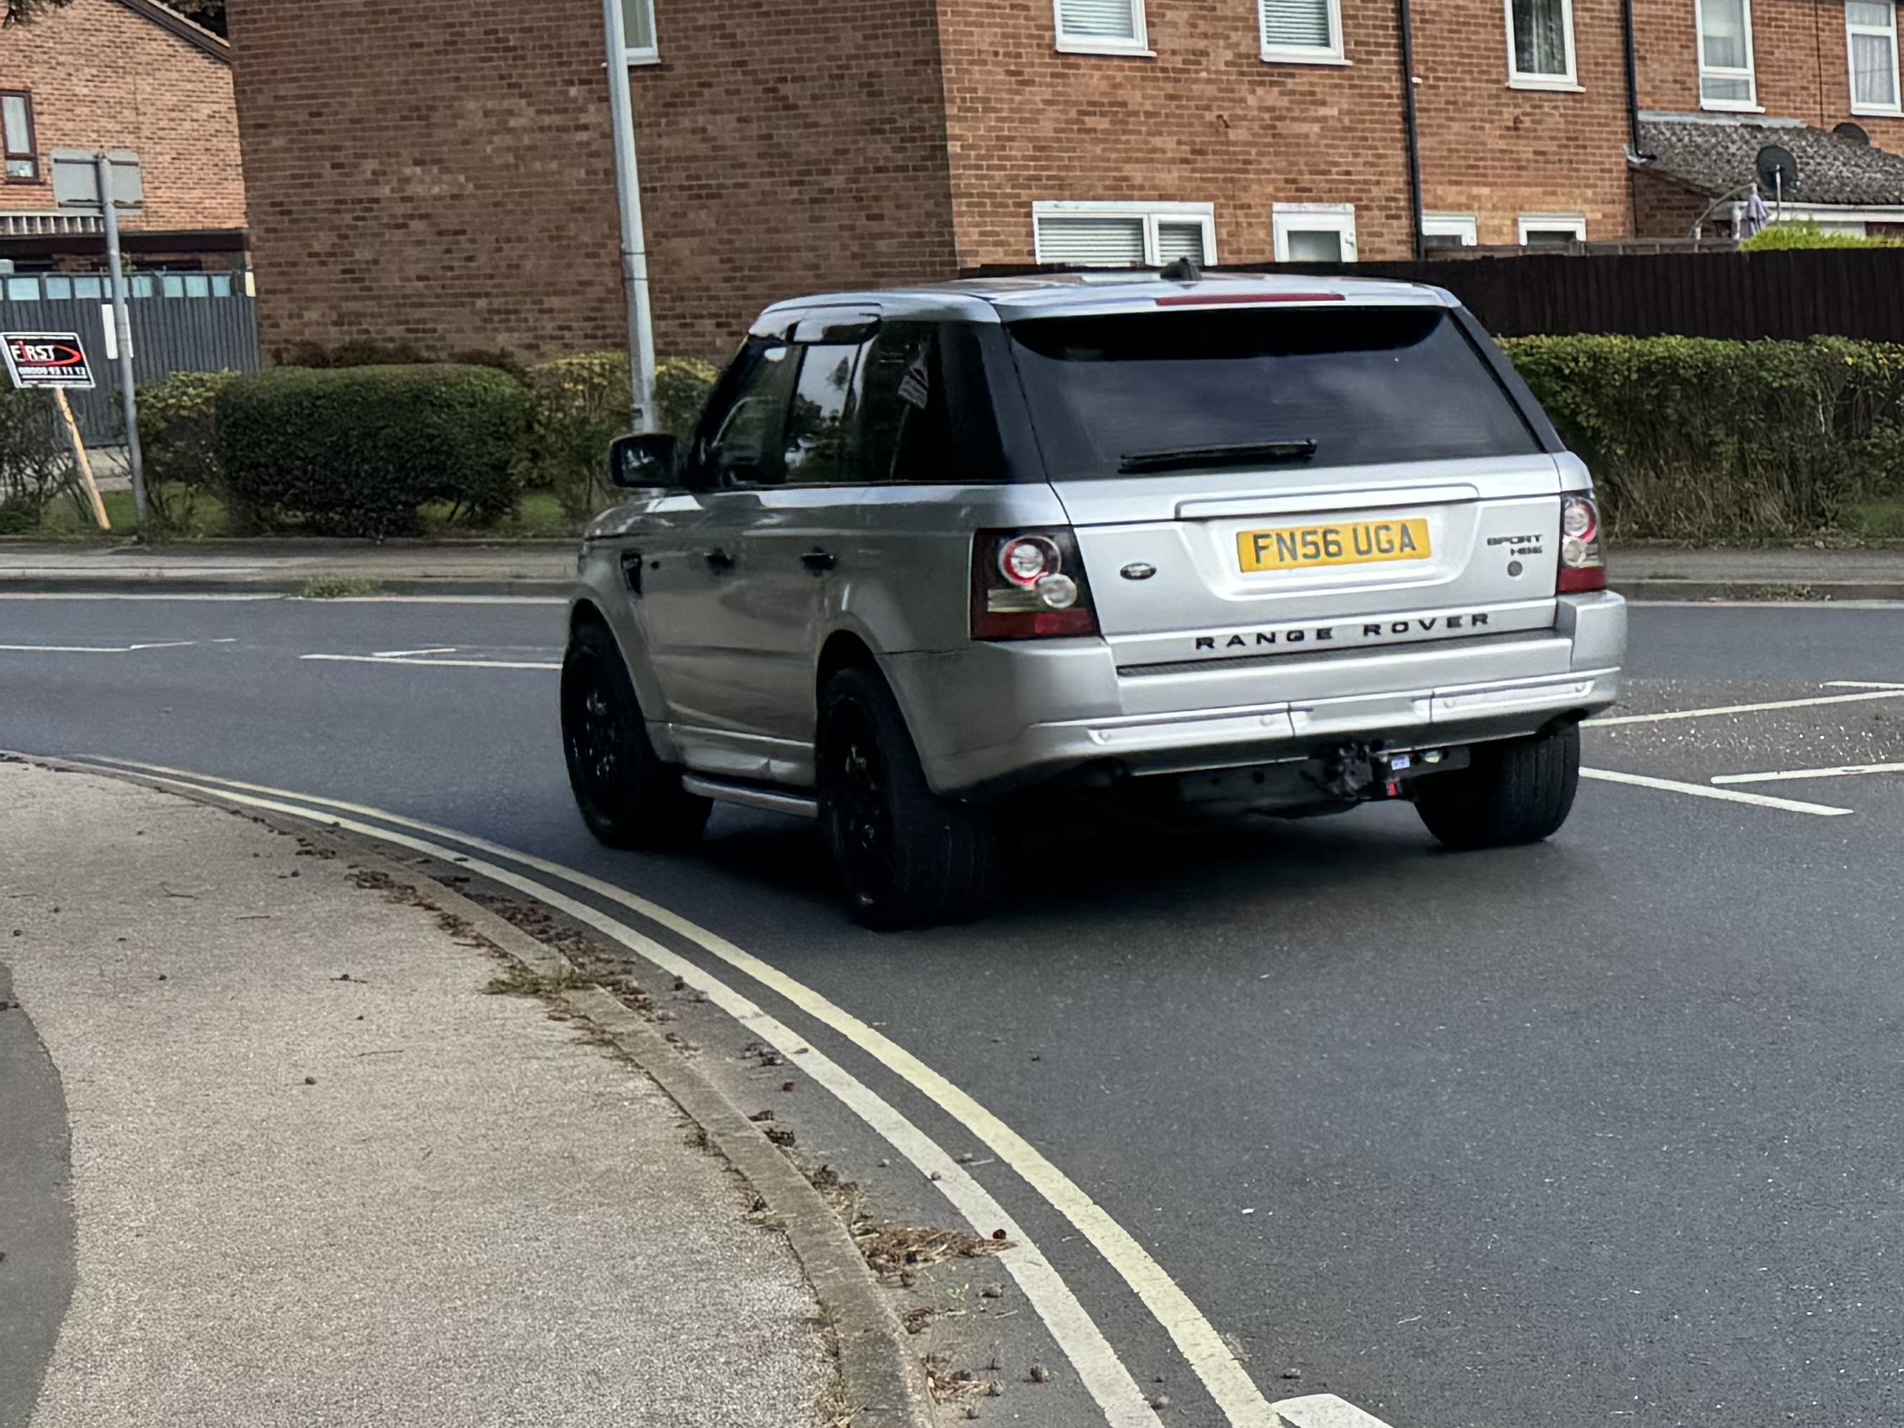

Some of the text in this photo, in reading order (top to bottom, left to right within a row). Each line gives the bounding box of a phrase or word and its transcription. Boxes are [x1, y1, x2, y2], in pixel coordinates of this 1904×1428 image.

[1253, 523, 1416, 564] FN56 UGA
[1195, 613, 1489, 650] RANGE ROVER
